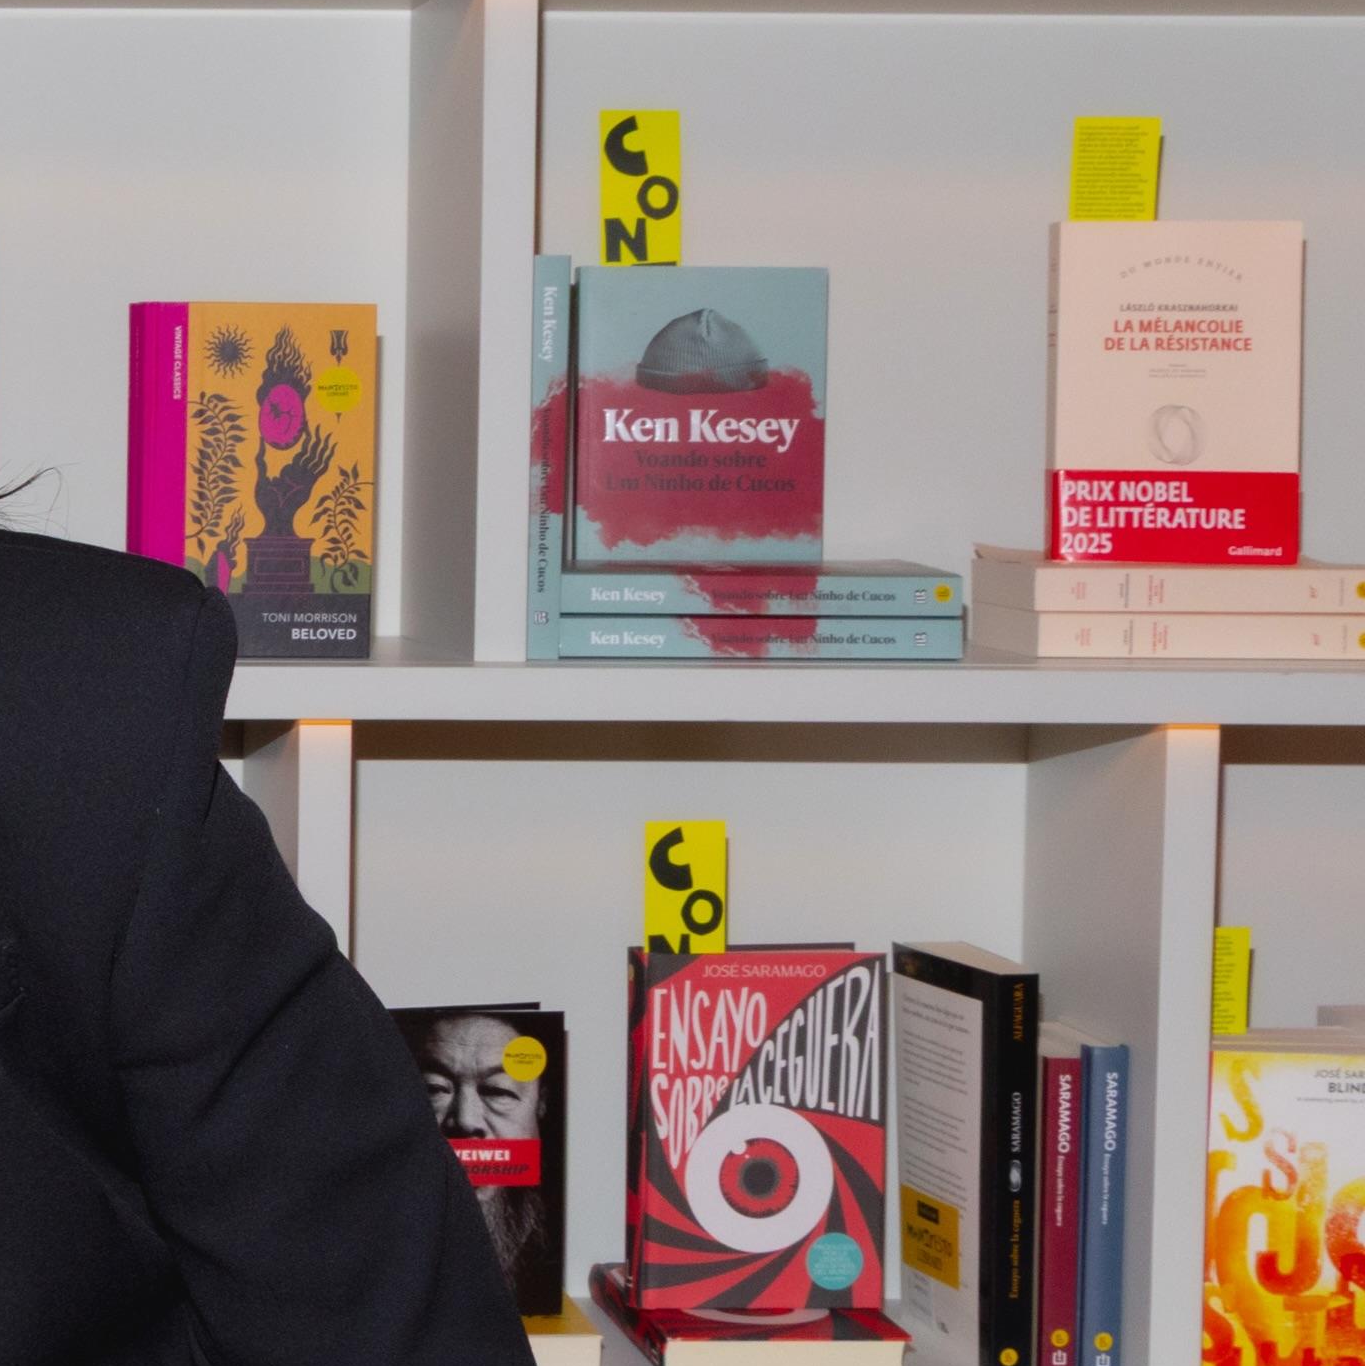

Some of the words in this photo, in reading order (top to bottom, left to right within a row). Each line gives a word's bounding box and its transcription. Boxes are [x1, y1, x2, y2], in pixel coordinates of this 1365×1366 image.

[1113, 319, 1135, 334] LA
[1138, 316, 1244, 335] MÉLANCOLIE
[1104, 337, 1125, 351] DE
[1130, 337, 1151, 351] LA
[1155, 335, 1253, 353] RÉSISTANCE
[601, 408, 679, 444] Ken
[689, 408, 800, 454] Kesey
[1061, 480, 1113, 502] PRIX
[1119, 481, 1193, 502] NOBEL
[1061, 506, 1092, 529] DE
[1096, 503, 1246, 531] LITTÉRATURE
[1060, 531, 1113, 554] 2025
[1227, 545, 1283, 558] Gallimard
[261, 613, 291, 623] TONI
[293, 613, 357, 623] MORRISON
[291, 628, 357, 641] BELOVED
[701, 963, 740, 979] JOSÉ
[741, 964, 827, 979] SARAMAGO
[650, 981, 767, 1074] ENSAYO
[1057, 1074, 1071, 1154] SARAMAGO
[1103, 1071, 1118, 1151] SARAMAGO
